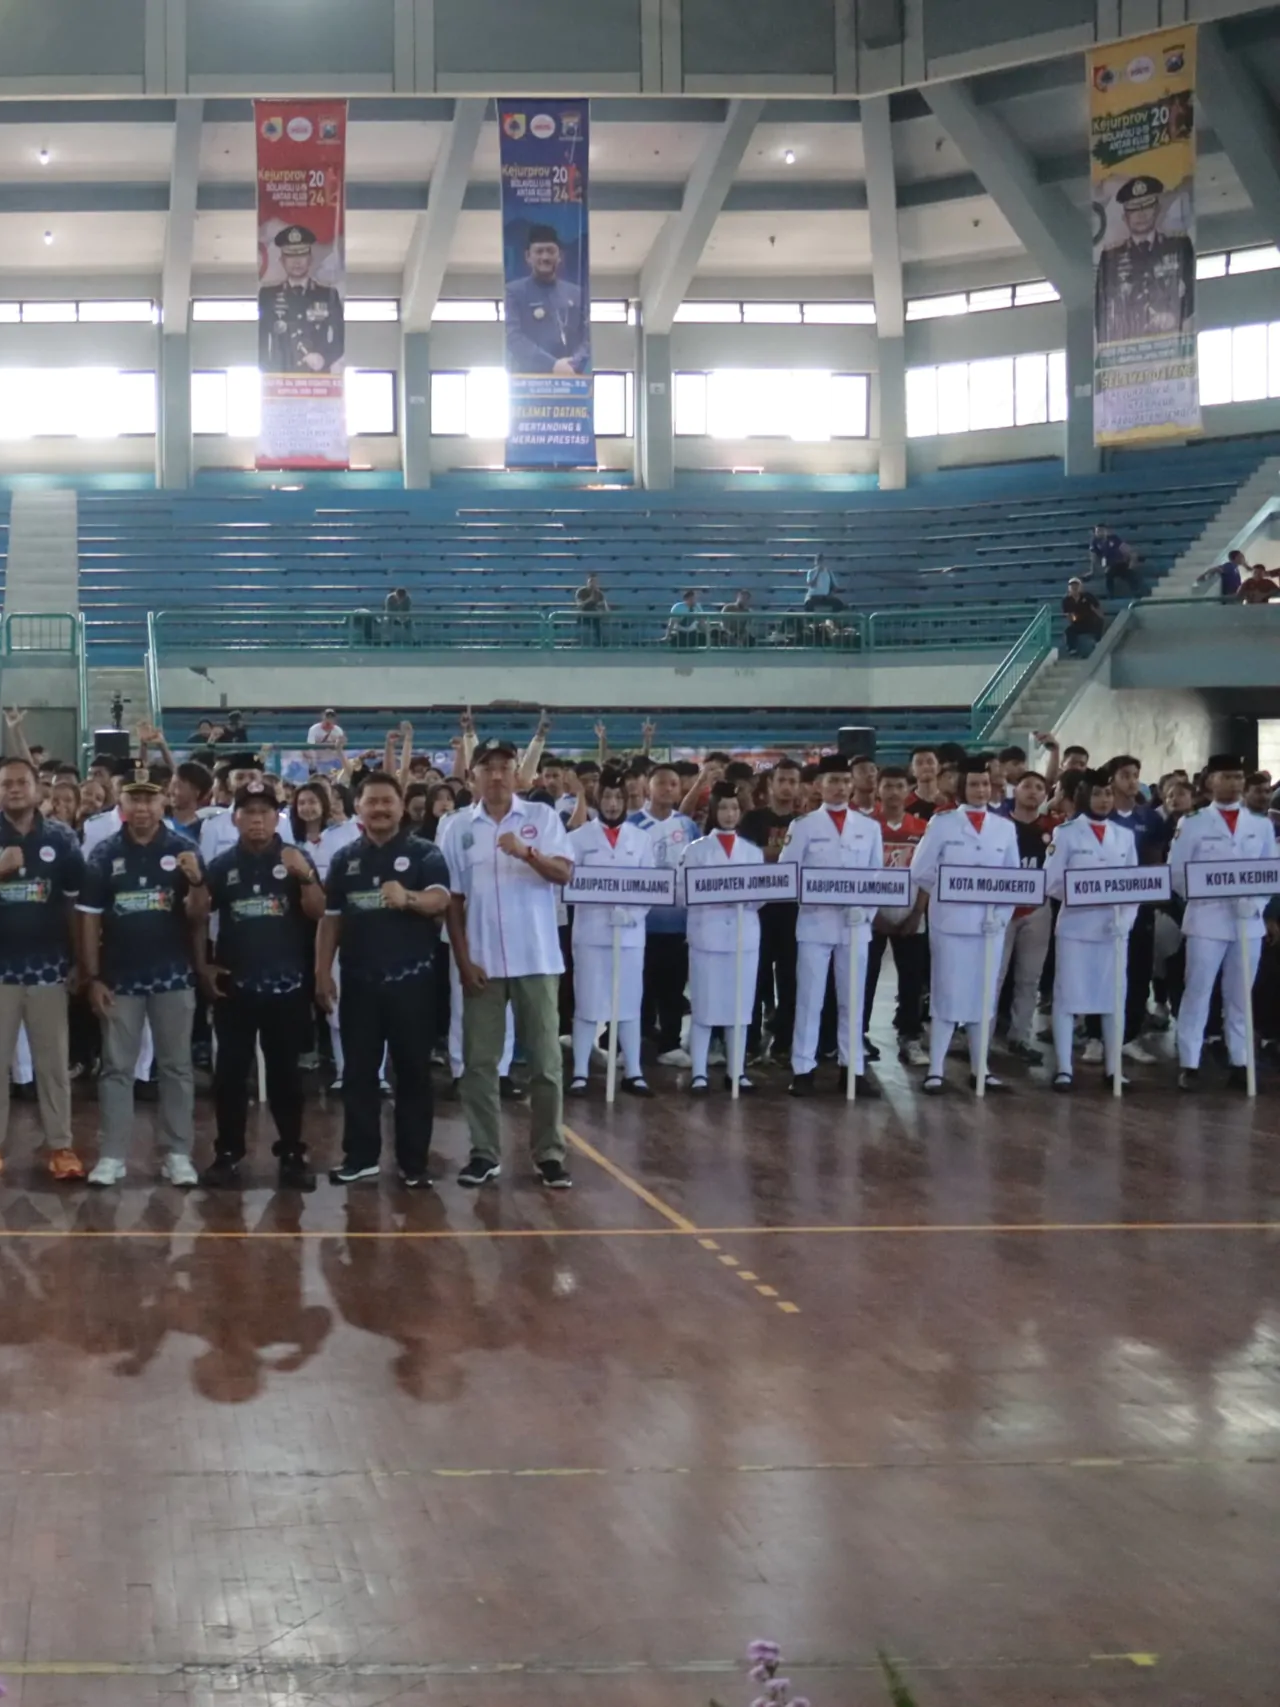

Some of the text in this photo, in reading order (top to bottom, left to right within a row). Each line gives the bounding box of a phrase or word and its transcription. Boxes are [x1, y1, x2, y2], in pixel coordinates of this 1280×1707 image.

[1092, 106, 1169, 133] Kejurprov 20
[258, 167, 324, 187] Kejurprov 20
[502, 164, 568, 184] Kejurprov 20
[621, 879, 669, 893] LUMAJANG
[695, 874, 789, 892] KABUPATEN JOMBANG
[949, 877, 1036, 893] KOTA MOJOKERTO
[1074, 877, 1162, 894] KOTA PASURUAN
[1206, 870, 1278, 886] KOTA KEDIRI
[806, 879, 905, 895] KABUPATEN LAMONGAN
